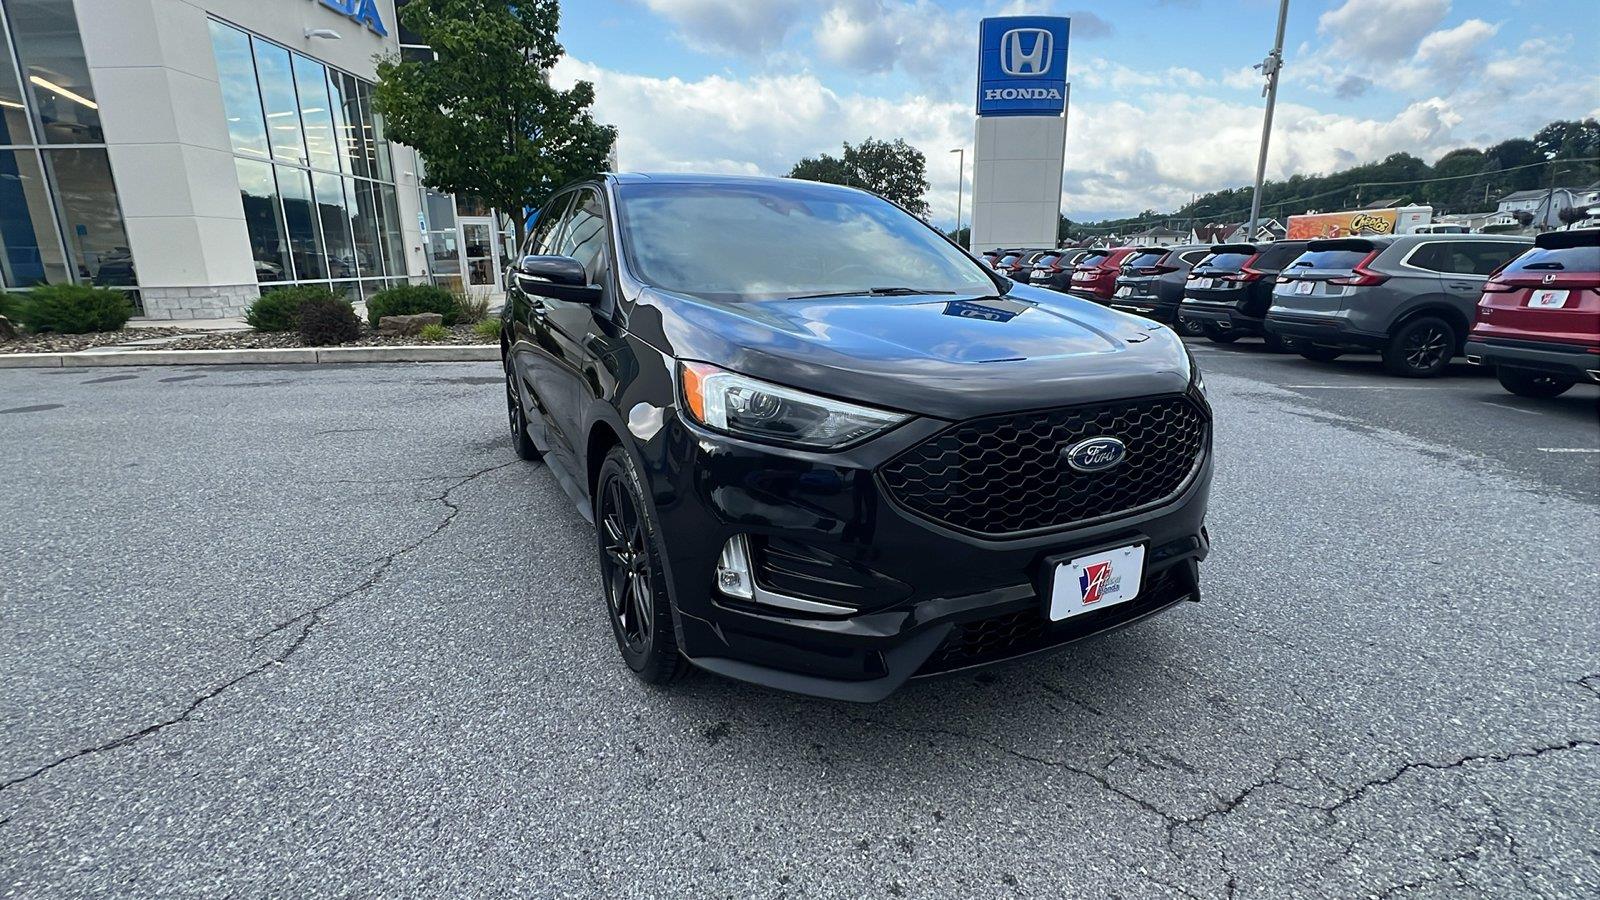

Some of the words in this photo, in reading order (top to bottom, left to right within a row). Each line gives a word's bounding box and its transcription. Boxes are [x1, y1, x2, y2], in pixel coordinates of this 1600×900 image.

[984, 88, 1062, 101] HONDA
[1351, 213, 1390, 233] Cheetos
[1084, 444, 1115, 465] Ford
